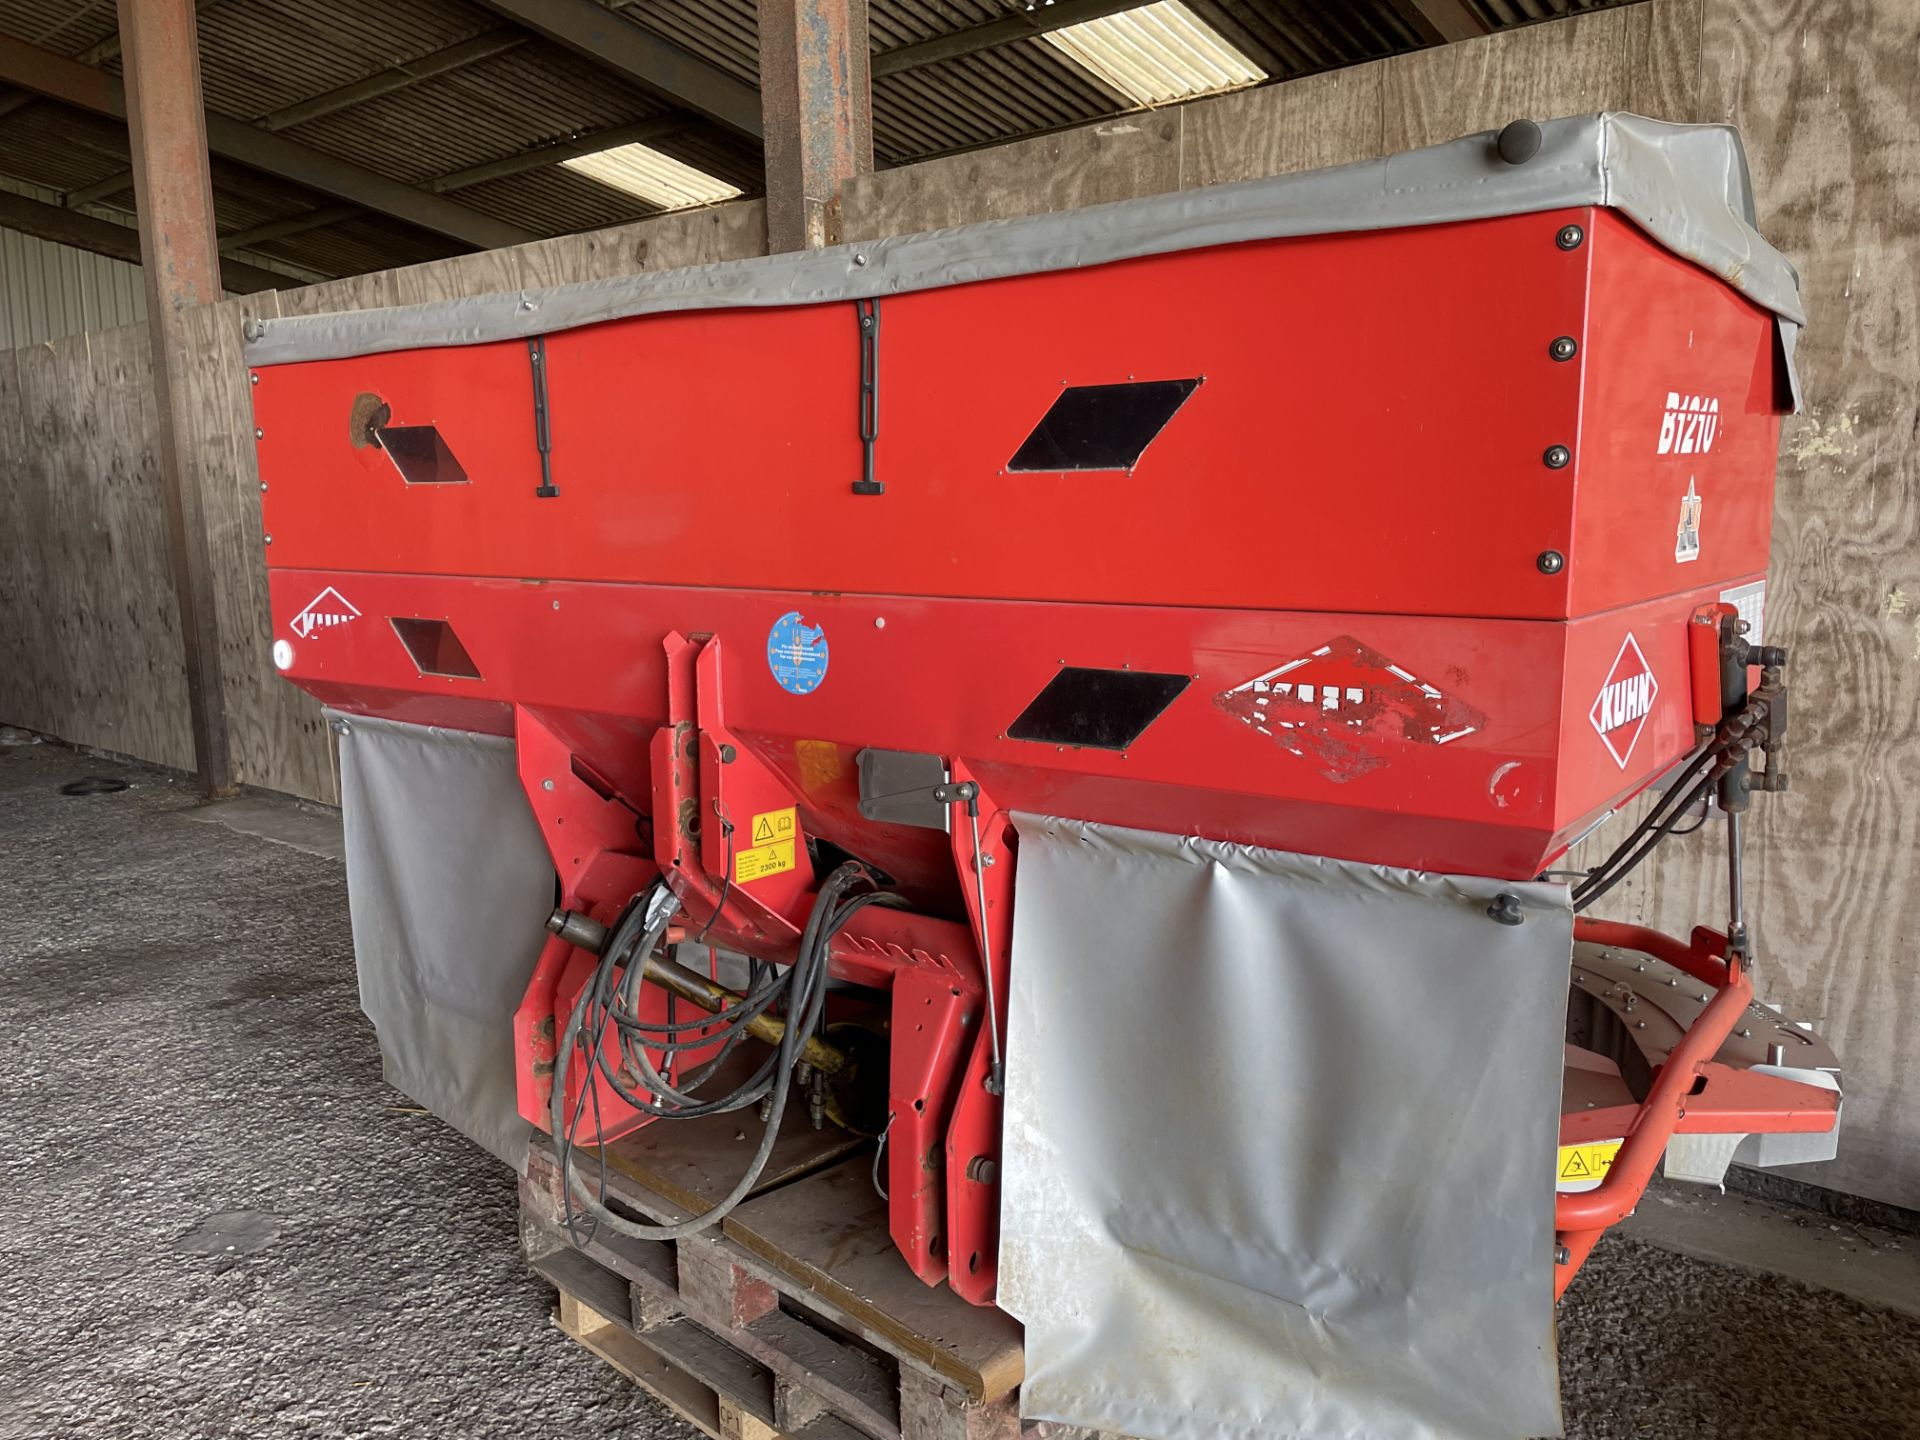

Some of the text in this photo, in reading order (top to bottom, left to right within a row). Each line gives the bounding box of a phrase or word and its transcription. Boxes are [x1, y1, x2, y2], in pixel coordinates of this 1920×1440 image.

[1657, 392, 1719, 455] B1210
[1600, 671, 1652, 735] KUHN
[760, 860, 786, 872] 2300 kg
